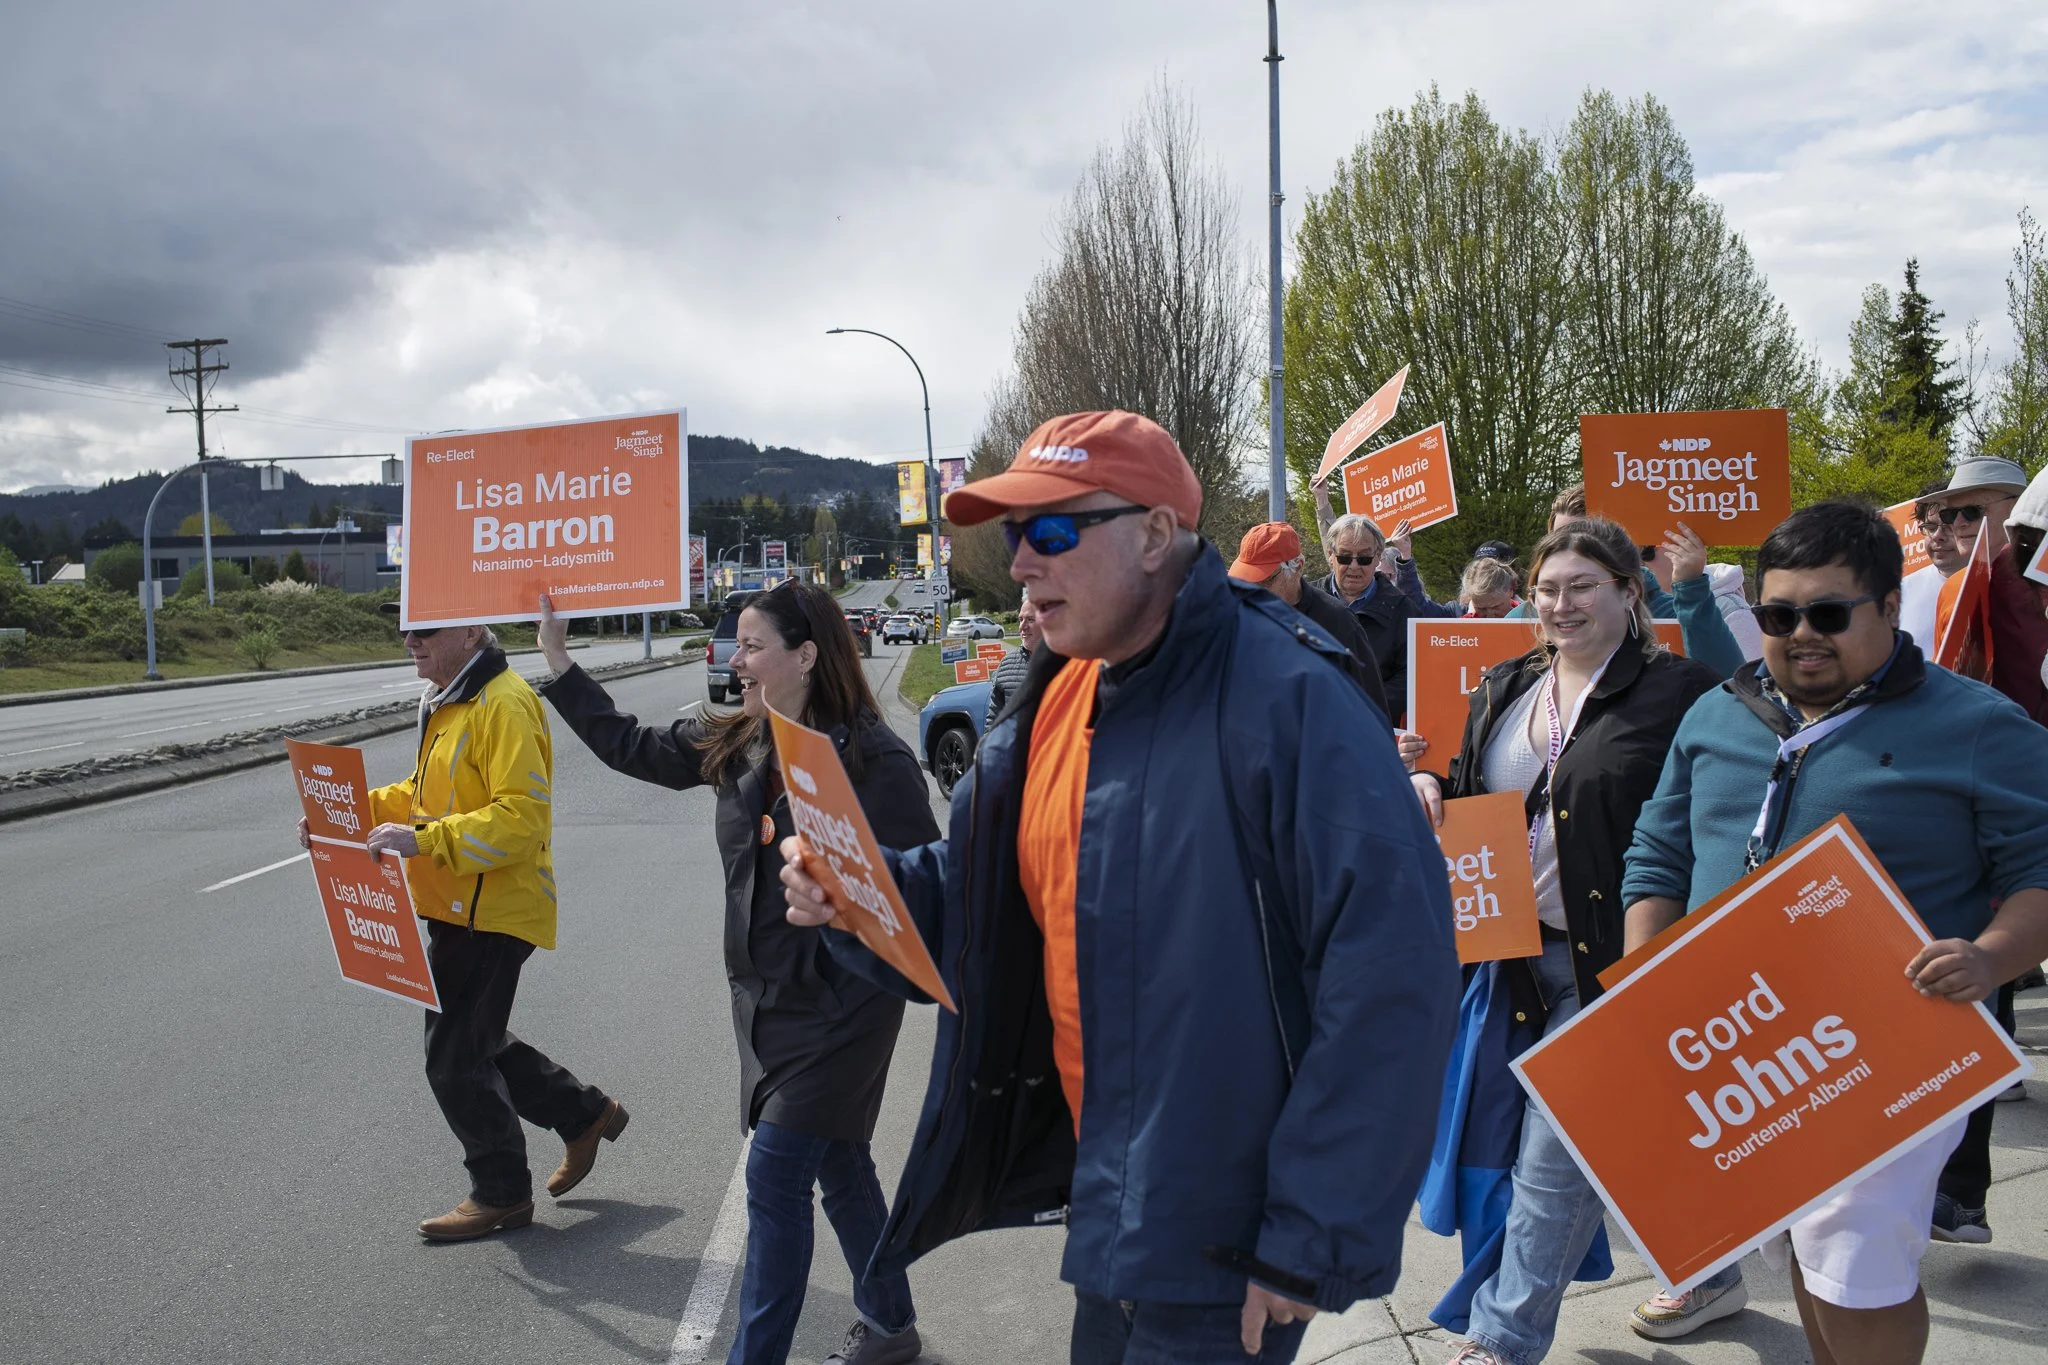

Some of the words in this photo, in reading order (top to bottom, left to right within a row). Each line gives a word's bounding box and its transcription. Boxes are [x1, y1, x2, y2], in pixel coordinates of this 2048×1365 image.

[426, 448, 475, 463] Re-Elect
[614, 433, 664, 450] Jagmeet
[633, 444, 664, 457] Singh
[1039, 445, 1088, 462] NDP
[1672, 438, 1711, 451] NDP
[1350, 464, 1369, 477] Re-Elect
[1363, 476, 1389, 495] Lisa
[1392, 457, 1429, 483] Marie
[1611, 451, 1758, 490] Jagmeet
[456, 478, 523, 510] Lisa
[535, 466, 632, 504] Marie
[1371, 479, 1425, 513] Barron
[1668, 482, 1760, 520] Singh
[473, 513, 614, 553] Barron
[1902, 539, 1925, 557] rro
[549, 578, 665, 596] LisaMarieBarron.ndp.ca
[933, 585, 947, 596] 50
[1430, 635, 1479, 648] Re-Elect
[299, 768, 357, 806] Jagmeet
[317, 764, 333, 777] NDP
[324, 803, 361, 835] Singh
[329, 876, 359, 905] Lisa
[357, 882, 397, 914] Marie
[1782, 874, 1843, 924] Jagmeet
[1812, 887, 1852, 917] Singh
[344, 907, 400, 948] Barron
[1668, 972, 1786, 1071] Gord
[1685, 1014, 1857, 1149] Johns
[1882, 1049, 1981, 1118] reelectgord.ca
